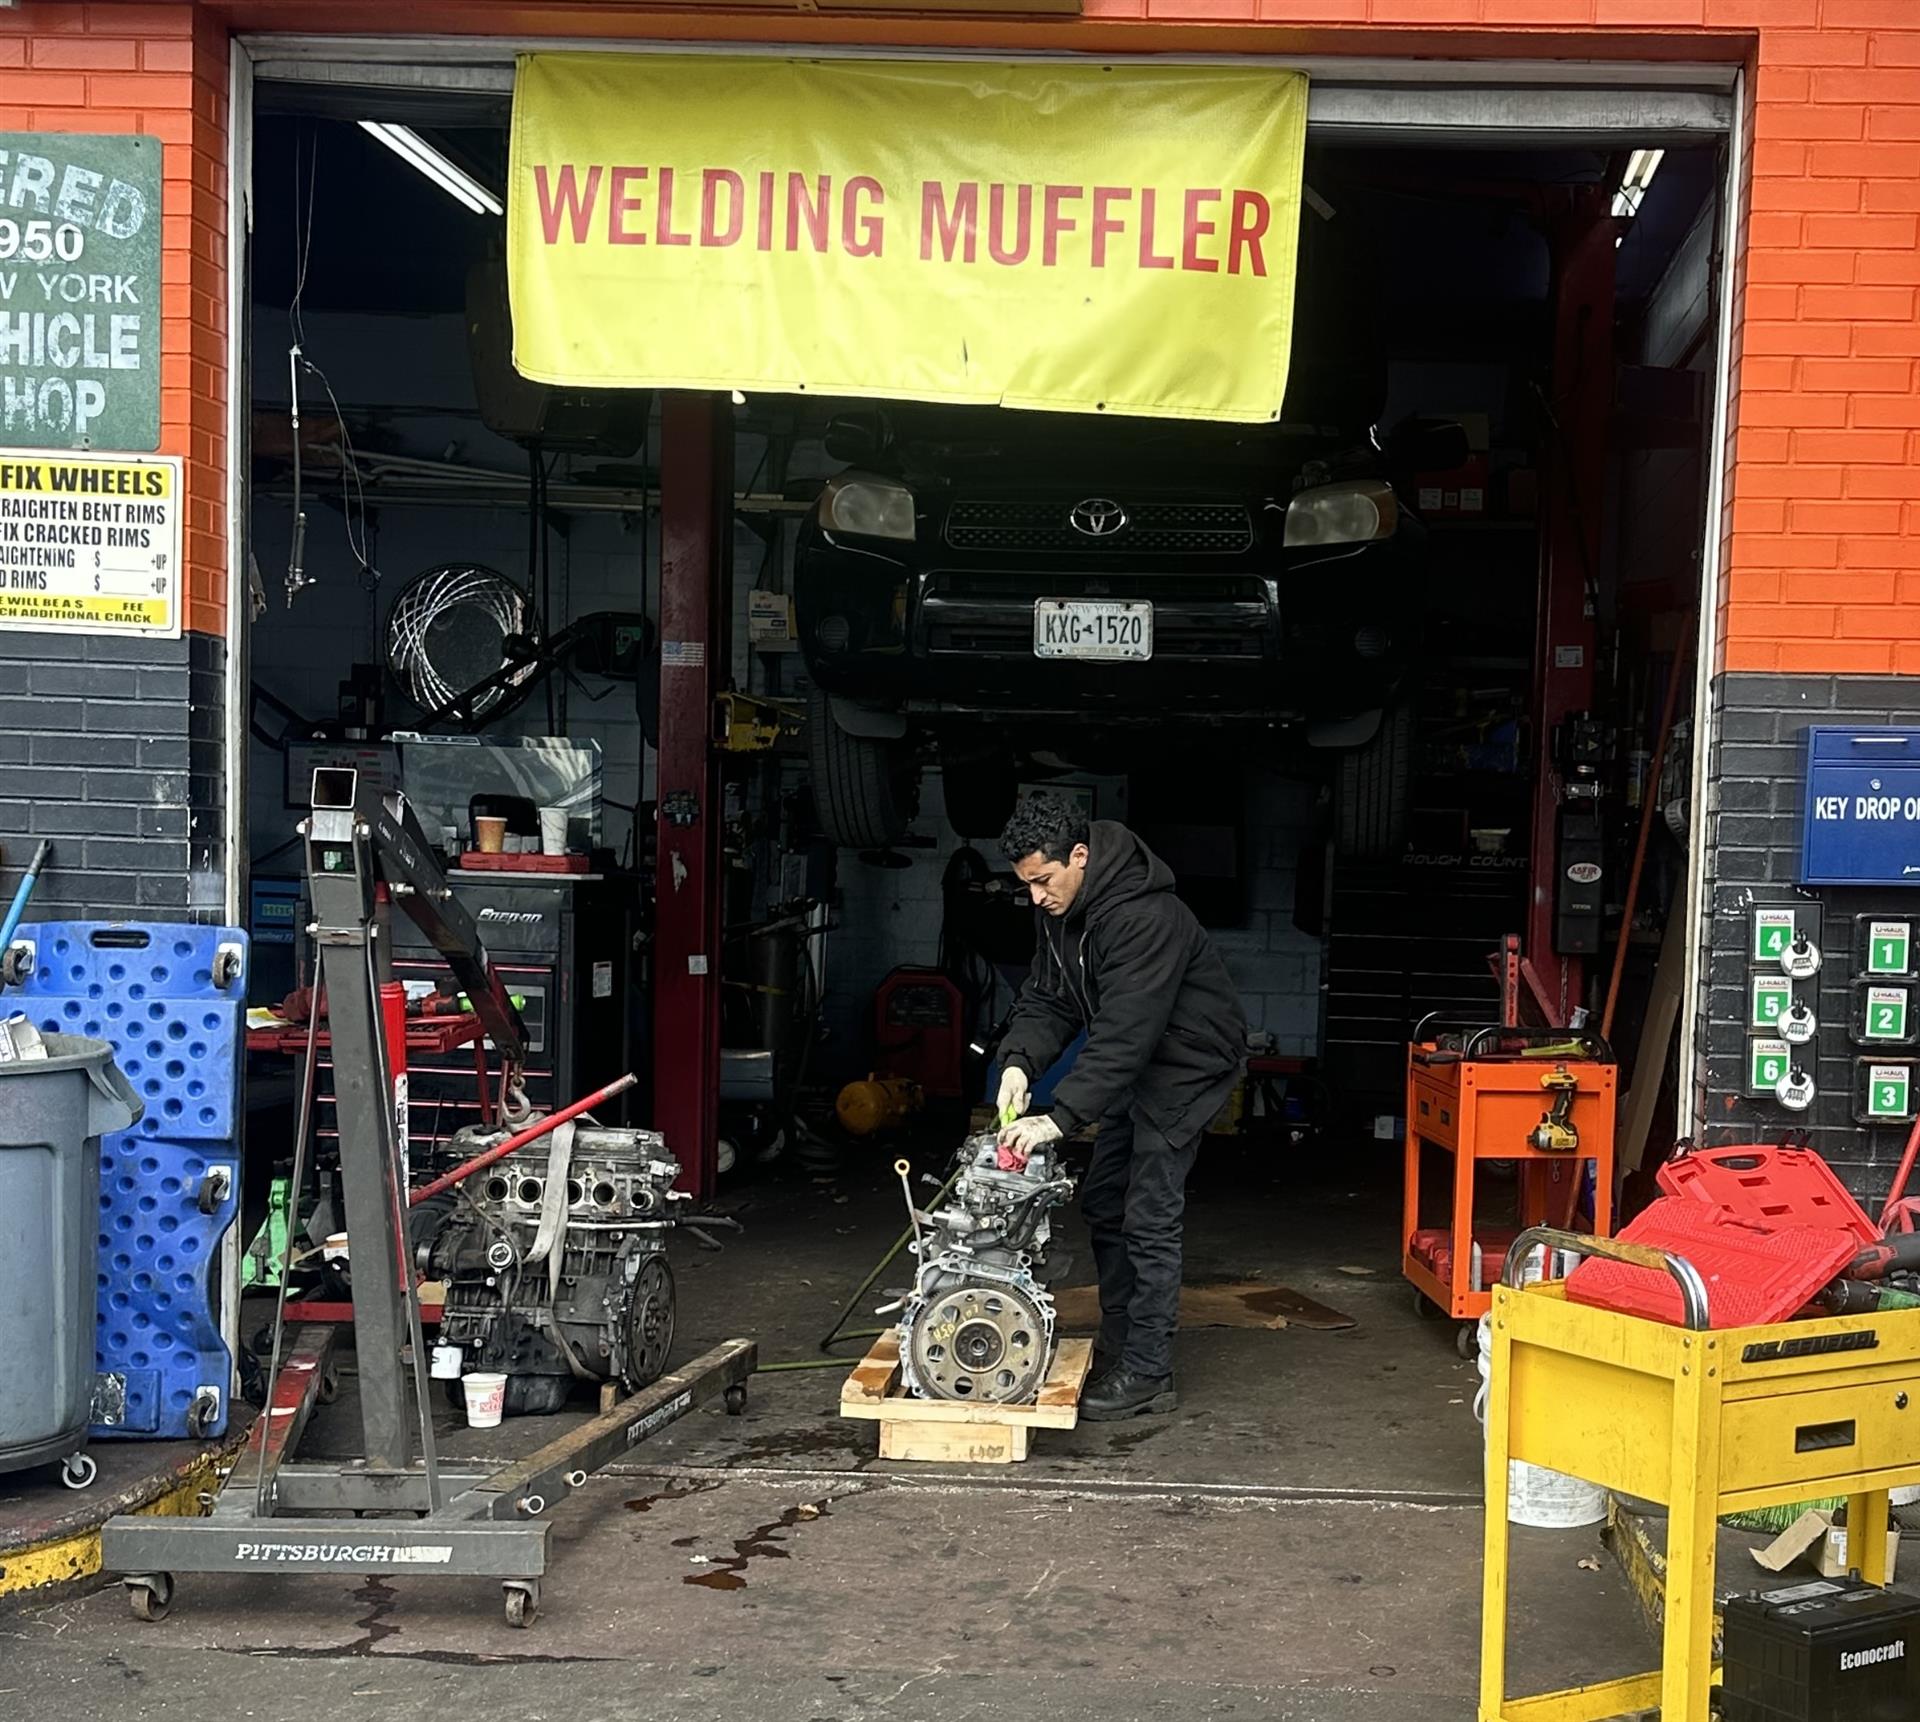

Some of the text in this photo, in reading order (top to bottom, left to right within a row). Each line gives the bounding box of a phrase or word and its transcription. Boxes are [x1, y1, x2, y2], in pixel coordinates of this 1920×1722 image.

[0, 149, 147, 239] RED
[533, 163, 1270, 277] WELDING MUFFLER
[36, 272, 140, 303] YORK
[0, 311, 140, 369] HICLE
[1, 464, 163, 496] FIX WHEELS
[82, 502, 122, 523] BENT
[126, 504, 166, 525] RIMS
[24, 523, 101, 545] CRACKED
[107, 527, 150, 548] RIMS
[94, 550, 100, 568] $
[11, 570, 47, 590] RIMS
[94, 573, 100, 591] $
[7, 596, 39, 607] WILL
[43, 598, 59, 608] BE
[122, 602, 144, 611] FEE
[21, 609, 101, 621] ADDITIONAL
[105, 612, 151, 623] CRACK
[1095, 615, 1141, 645] 1520
[1815, 797, 1849, 820] KEY
[1855, 797, 1901, 820] DROP
[1768, 931, 1782, 951] 4
[1882, 943, 1893, 964] 1
[1765, 997, 1779, 1017] 5
[1878, 1008, 1894, 1029] 2
[1763, 1060, 1779, 1081] 6
[1881, 1086, 1896, 1107] 3
[235, 1543, 393, 1563] PITTSBURGH
[1840, 1640, 1905, 1671] Econocraft
